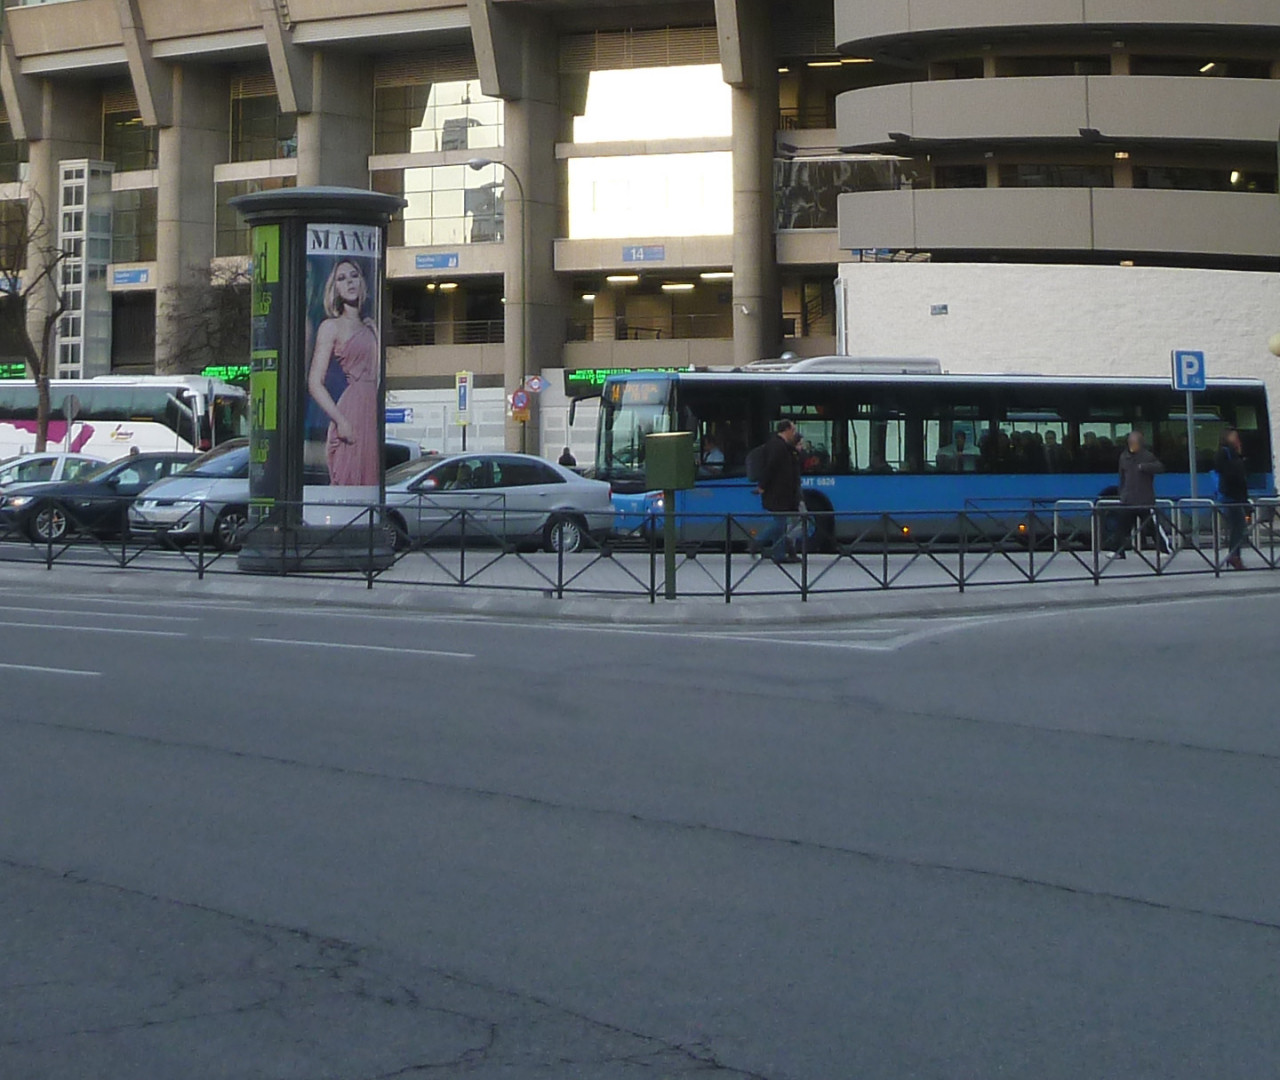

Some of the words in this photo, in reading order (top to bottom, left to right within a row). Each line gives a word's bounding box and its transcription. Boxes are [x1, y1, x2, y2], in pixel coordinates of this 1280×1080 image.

[311, 229, 381, 251] MANG
[631, 247, 644, 261] 14
[1181, 354, 1199, 386] P
